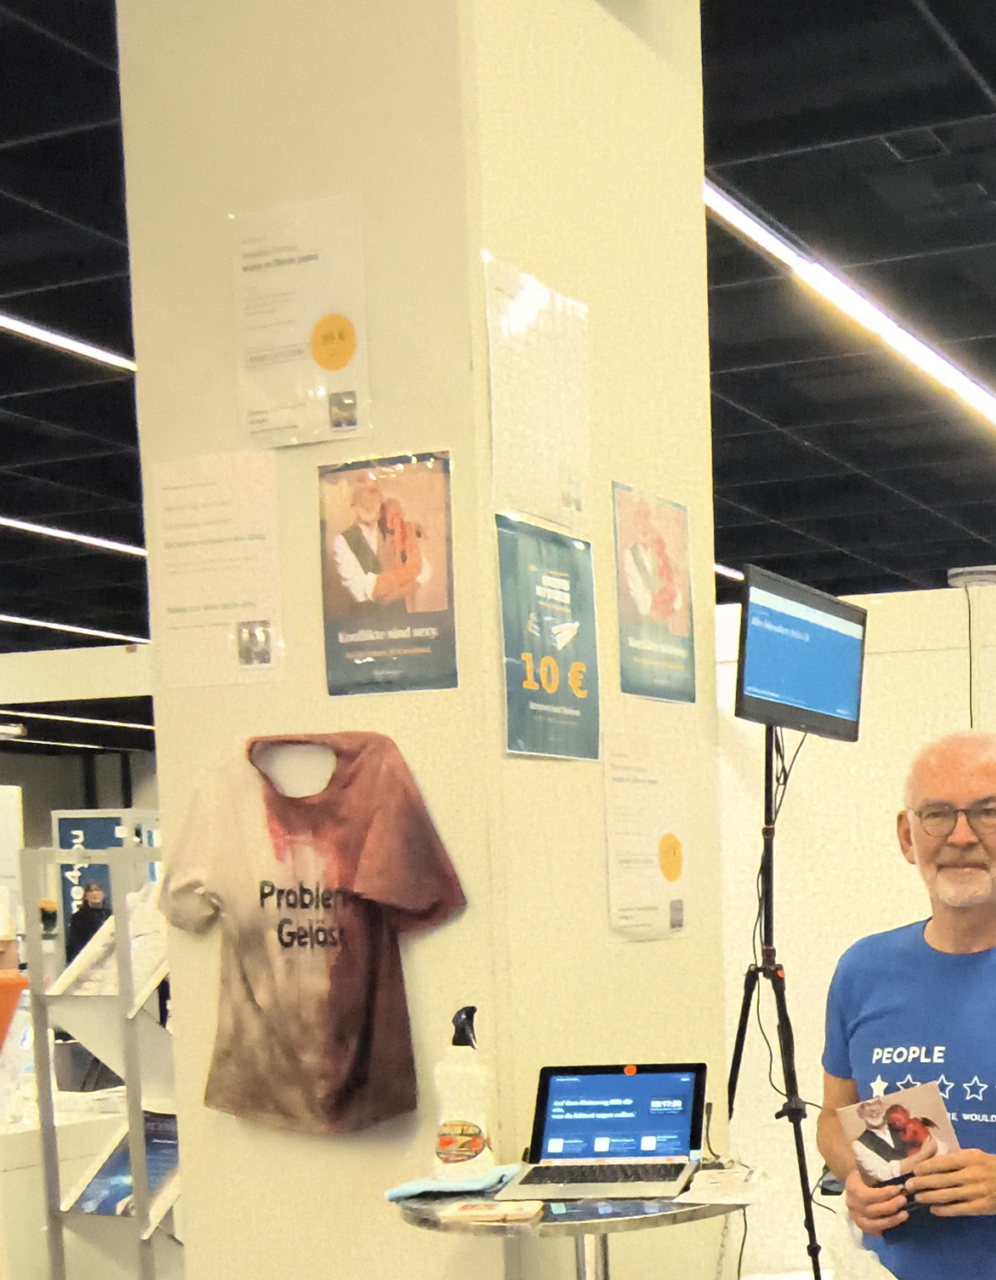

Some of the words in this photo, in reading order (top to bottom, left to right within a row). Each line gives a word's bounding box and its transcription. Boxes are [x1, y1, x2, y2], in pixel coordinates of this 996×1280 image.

[520, 652, 559, 693] 10
[568, 661, 588, 699] €
[872, 1046, 946, 1064] PEOPLE
